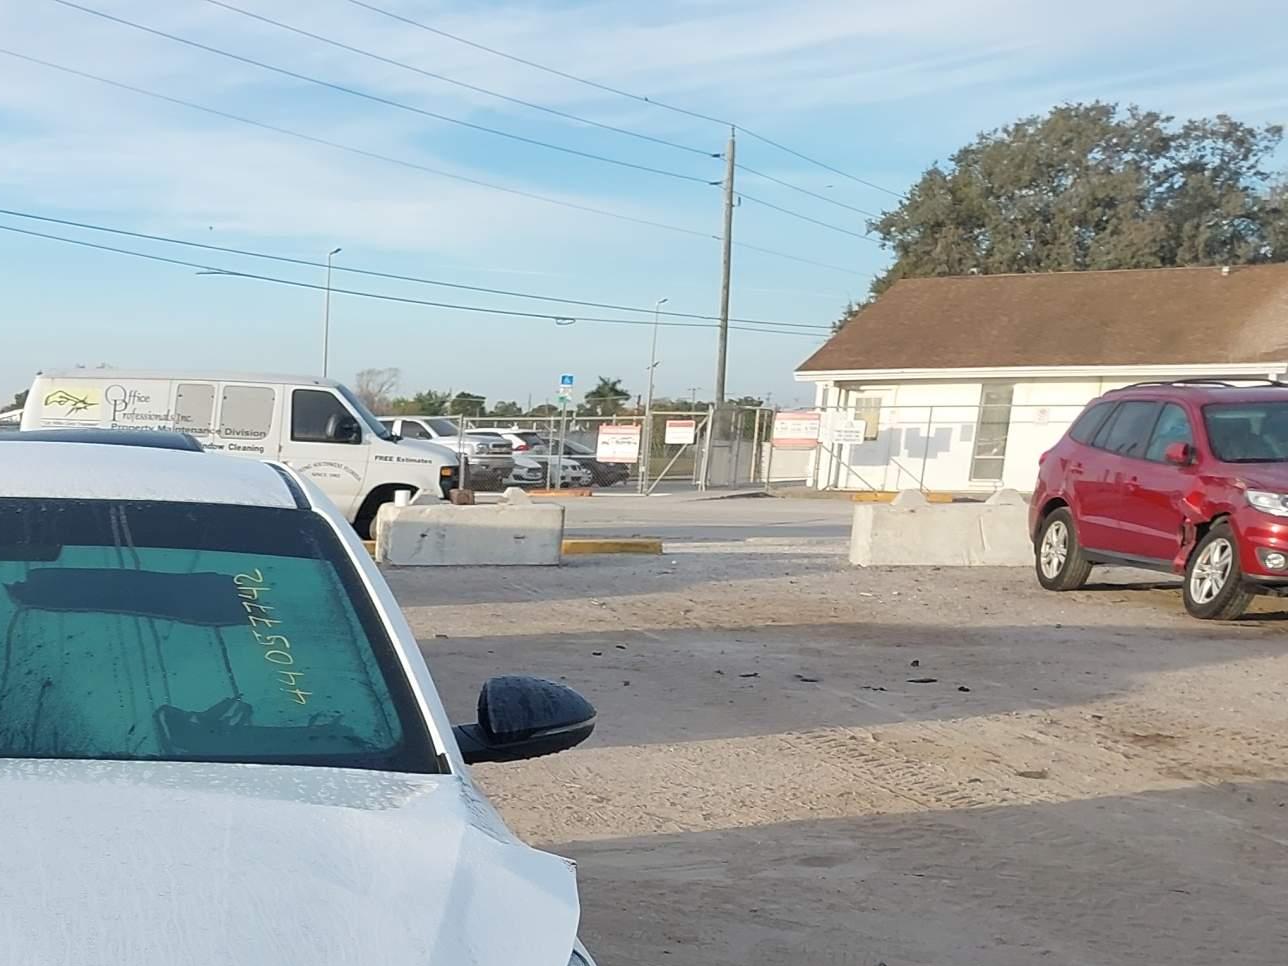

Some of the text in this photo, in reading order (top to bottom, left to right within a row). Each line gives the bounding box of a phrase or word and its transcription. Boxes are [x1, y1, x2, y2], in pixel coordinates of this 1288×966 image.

[105, 384, 151, 405] Office
[224, 428, 266, 437] Division
[228, 443, 265, 454] Cleaning
[396, 456, 432, 464] Estimates
[233, 568, 313, 705] 44057742
